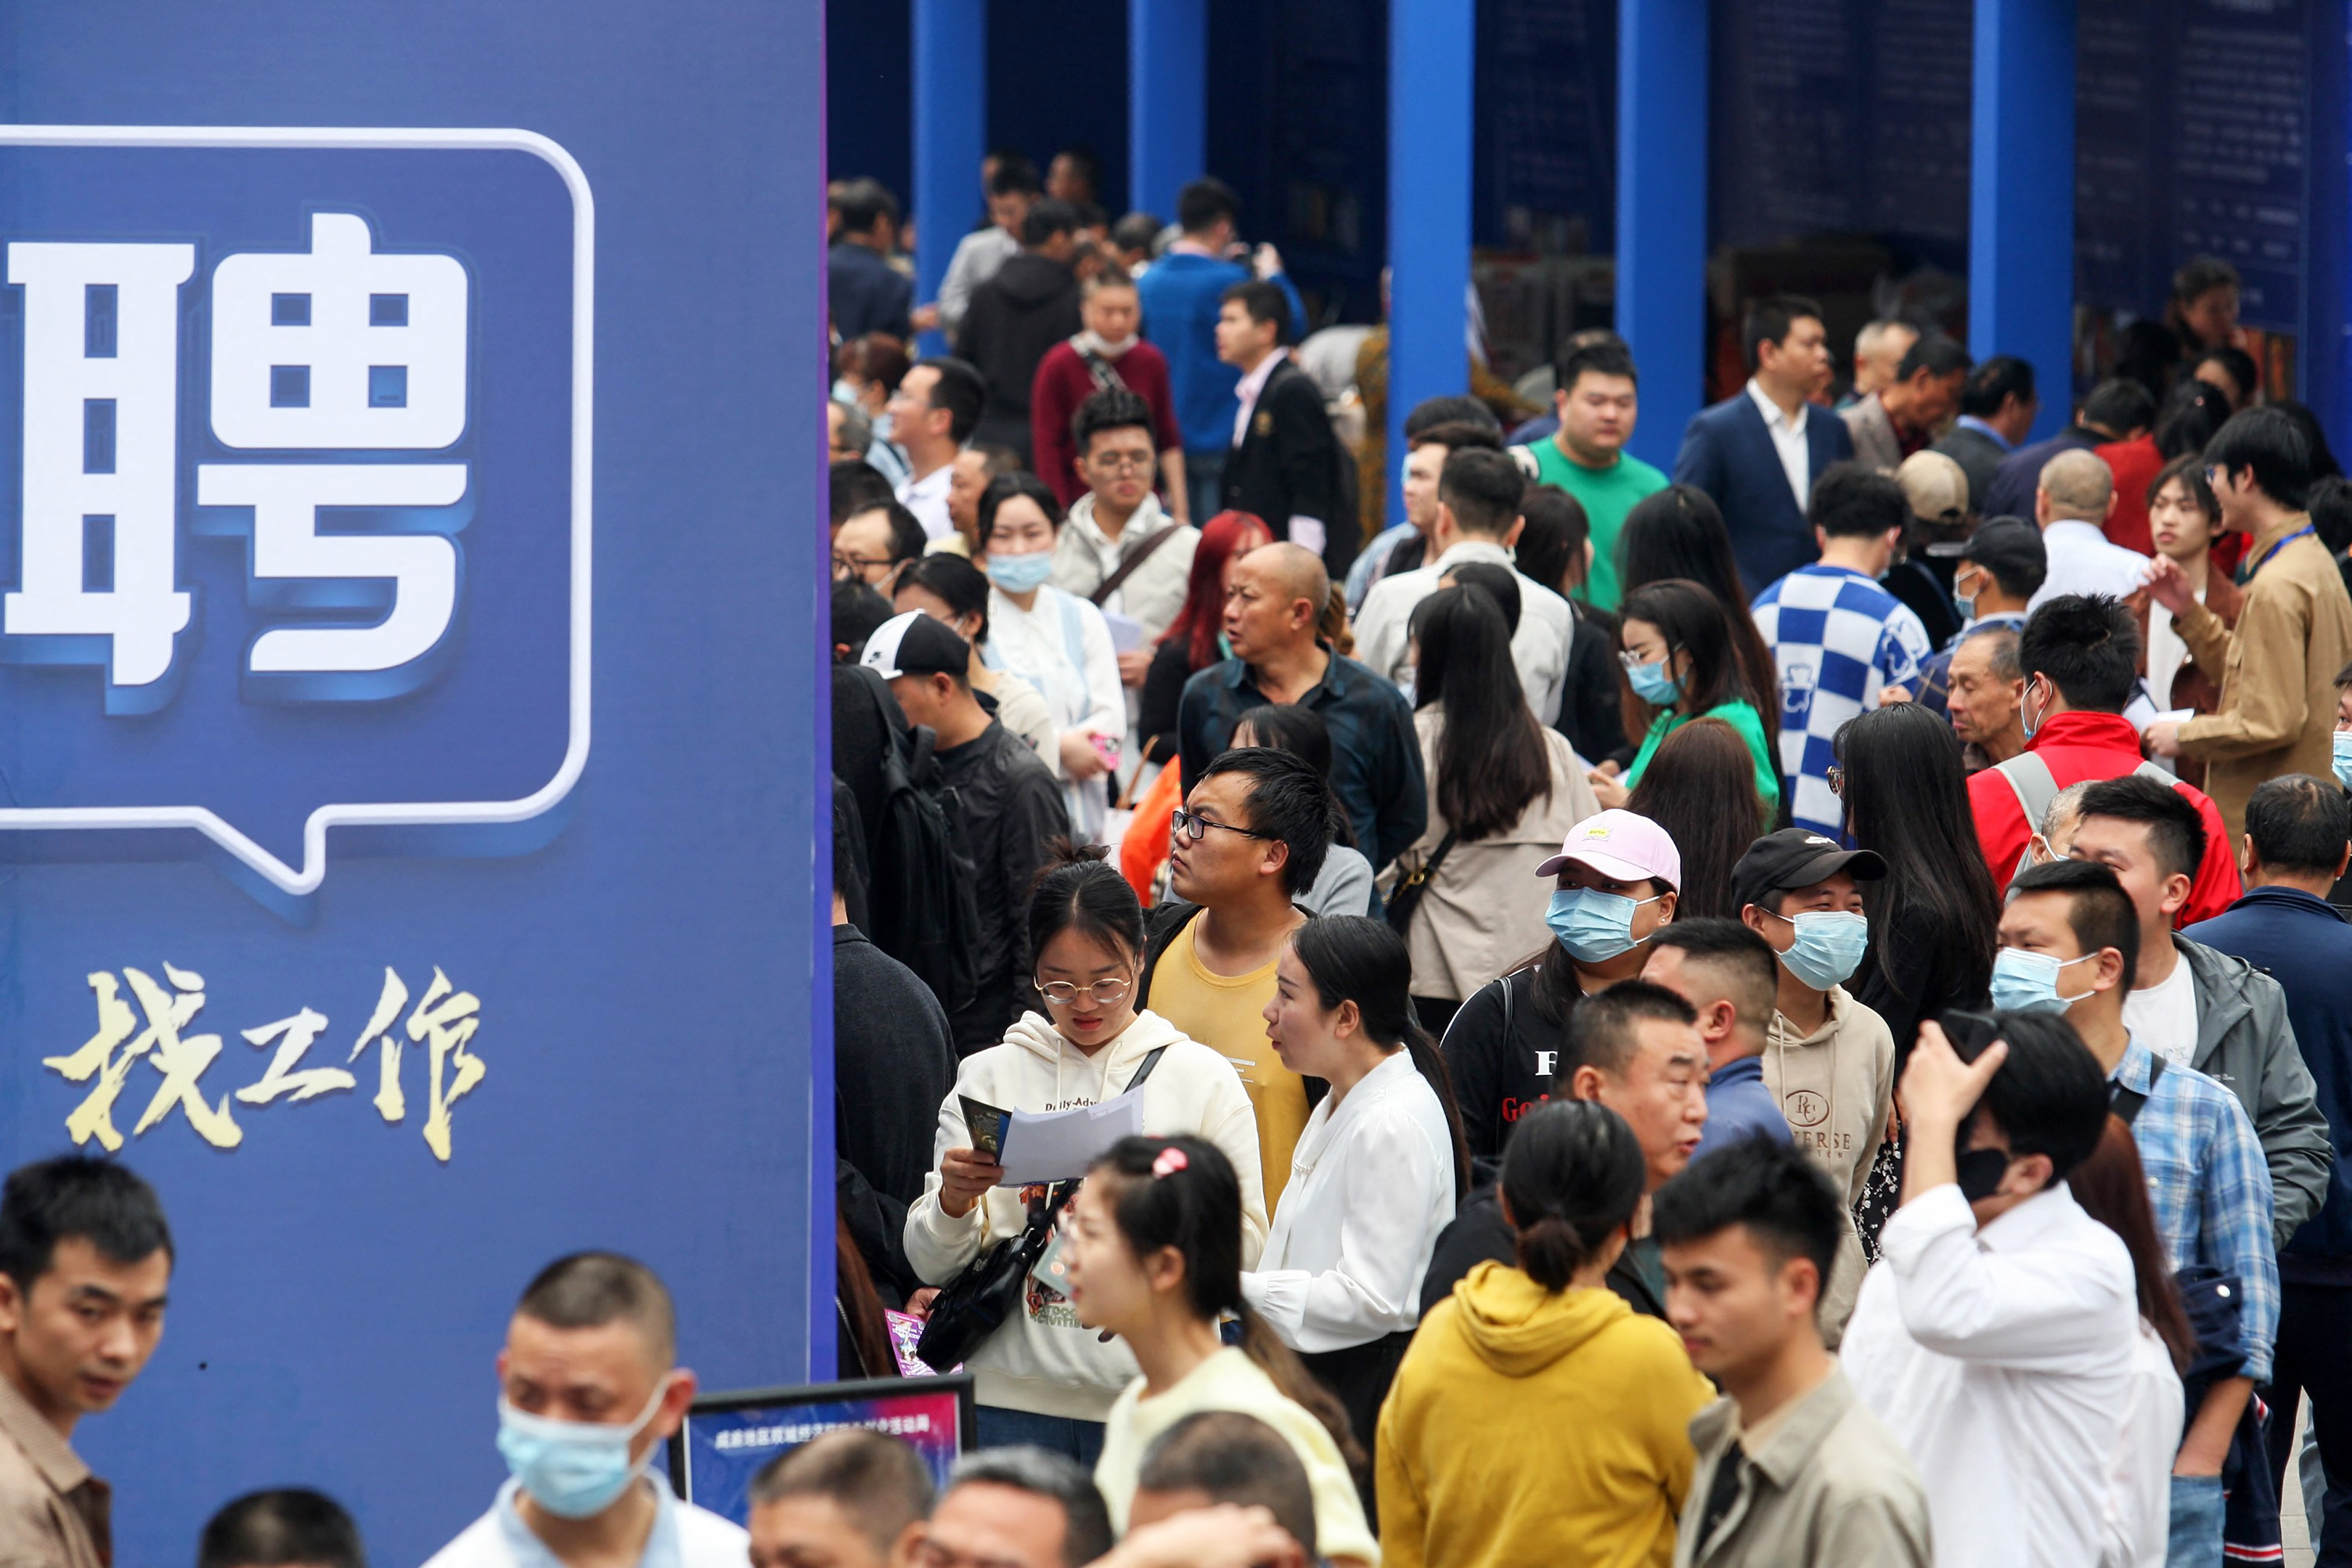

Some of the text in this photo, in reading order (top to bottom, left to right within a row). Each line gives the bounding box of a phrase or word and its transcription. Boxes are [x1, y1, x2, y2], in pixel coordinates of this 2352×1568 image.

[4, 213, 468, 685] 聘
[42, 961, 486, 1161] 找工作
